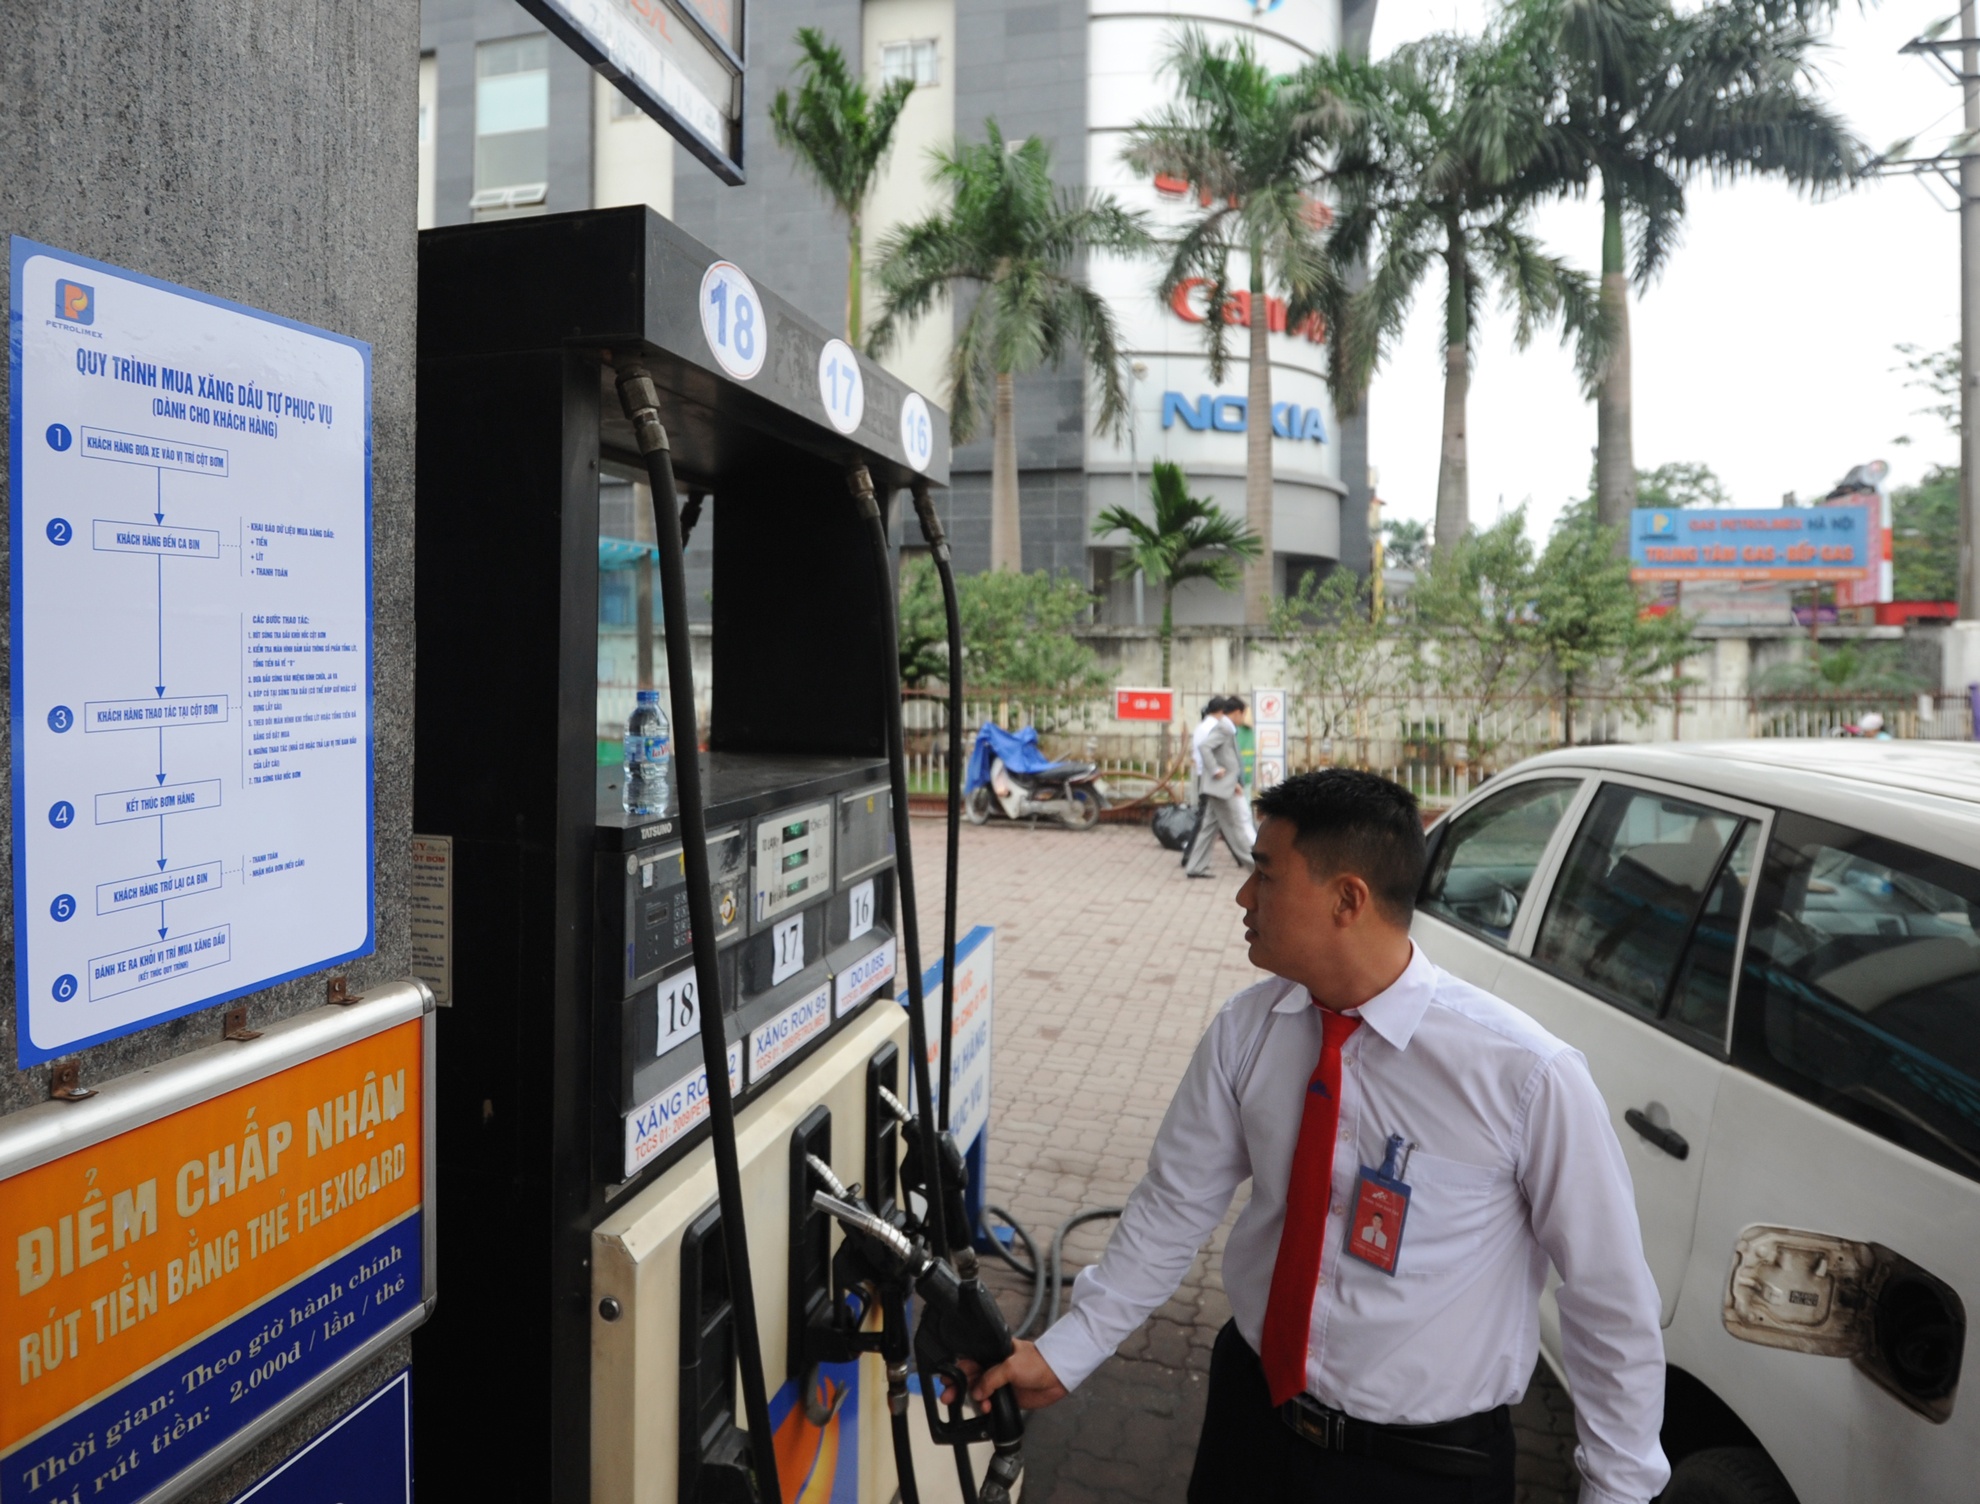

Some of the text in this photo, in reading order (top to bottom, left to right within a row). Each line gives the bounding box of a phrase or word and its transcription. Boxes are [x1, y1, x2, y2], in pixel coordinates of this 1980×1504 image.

[46, 320, 103, 339] PETROLIMEX
[710, 278, 755, 361] 18
[76, 347, 333, 430] QUY TRÌNH MUA XĂNG DẦU TỰ PHỤC VỤ
[826, 357, 856, 418] 17
[152, 396, 278, 440] (DÀNH CHO KHÁCH HÀNG)
[906, 408, 927, 458] 16
[1162, 390, 1329, 445] NOKIA
[86, 435, 224, 468] KHÁCH HÀNG ĐƯA XE VÀO VỊ TRÍ CỘT BƠM
[53, 523, 66, 542] 2
[116, 531, 200, 550] KHÁCH HÀNG ĐẾN CA BIN
[54, 710, 67, 729] 3
[97, 703, 219, 723] KHÁCH HÀNG THAO TÁC TẠI CỘT BƠM
[55, 805, 68, 824] 4
[126, 791, 195, 813] KẾT THÚC BƠM HÀNG
[641, 823, 672, 840] TATSUNO
[113, 872, 208, 903] KHÁCH HÀNG TRỞ LẠI CA BIN
[57, 898, 70, 918] 5
[855, 891, 869, 927] 16
[95, 962, 116, 980] ĐÁNH
[117, 961, 127, 972] XE
[128, 958, 138, 970] RA
[139, 949, 156, 968] KHỎI
[157, 950, 165, 964] VỊ
[165, 945, 176, 959] TRÍ
[177, 943, 193, 957] MUA
[193, 938, 212, 952] XĂNG
[778, 923, 799, 967] 17
[163, 964, 173, 975] QUY
[851, 967, 863, 989] DO
[59, 979, 72, 998] 6
[666, 982, 694, 1037] 18
[756, 992, 827, 1057] XĂNG RON 95
[636, 1092, 682, 1143] XĂNG
[687, 1074, 708, 1105] RO
[635, 1126, 671, 1161] TCCS 01:
[15, 1068, 406, 1297] ĐIỂM CHẤP NHẬN
[19, 1142, 405, 1386] RÚT TIỀN BẰNG THẺ FLEXICARD
[22, 1430, 97, 1494] Thời
[106, 1387, 175, 1456] gian:
[181, 1348, 242, 1395] Theo
[248, 1318, 284, 1359] giờ
[289, 1282, 344, 1329] hành
[348, 1245, 403, 1290] chính
[94, 1449, 140, 1494] rút
[151, 1406, 211, 1456] tiền:
[229, 1340, 302, 1404] 2.000đ
[323, 1310, 356, 1342] lần
[375, 1272, 405, 1306] thẻ
